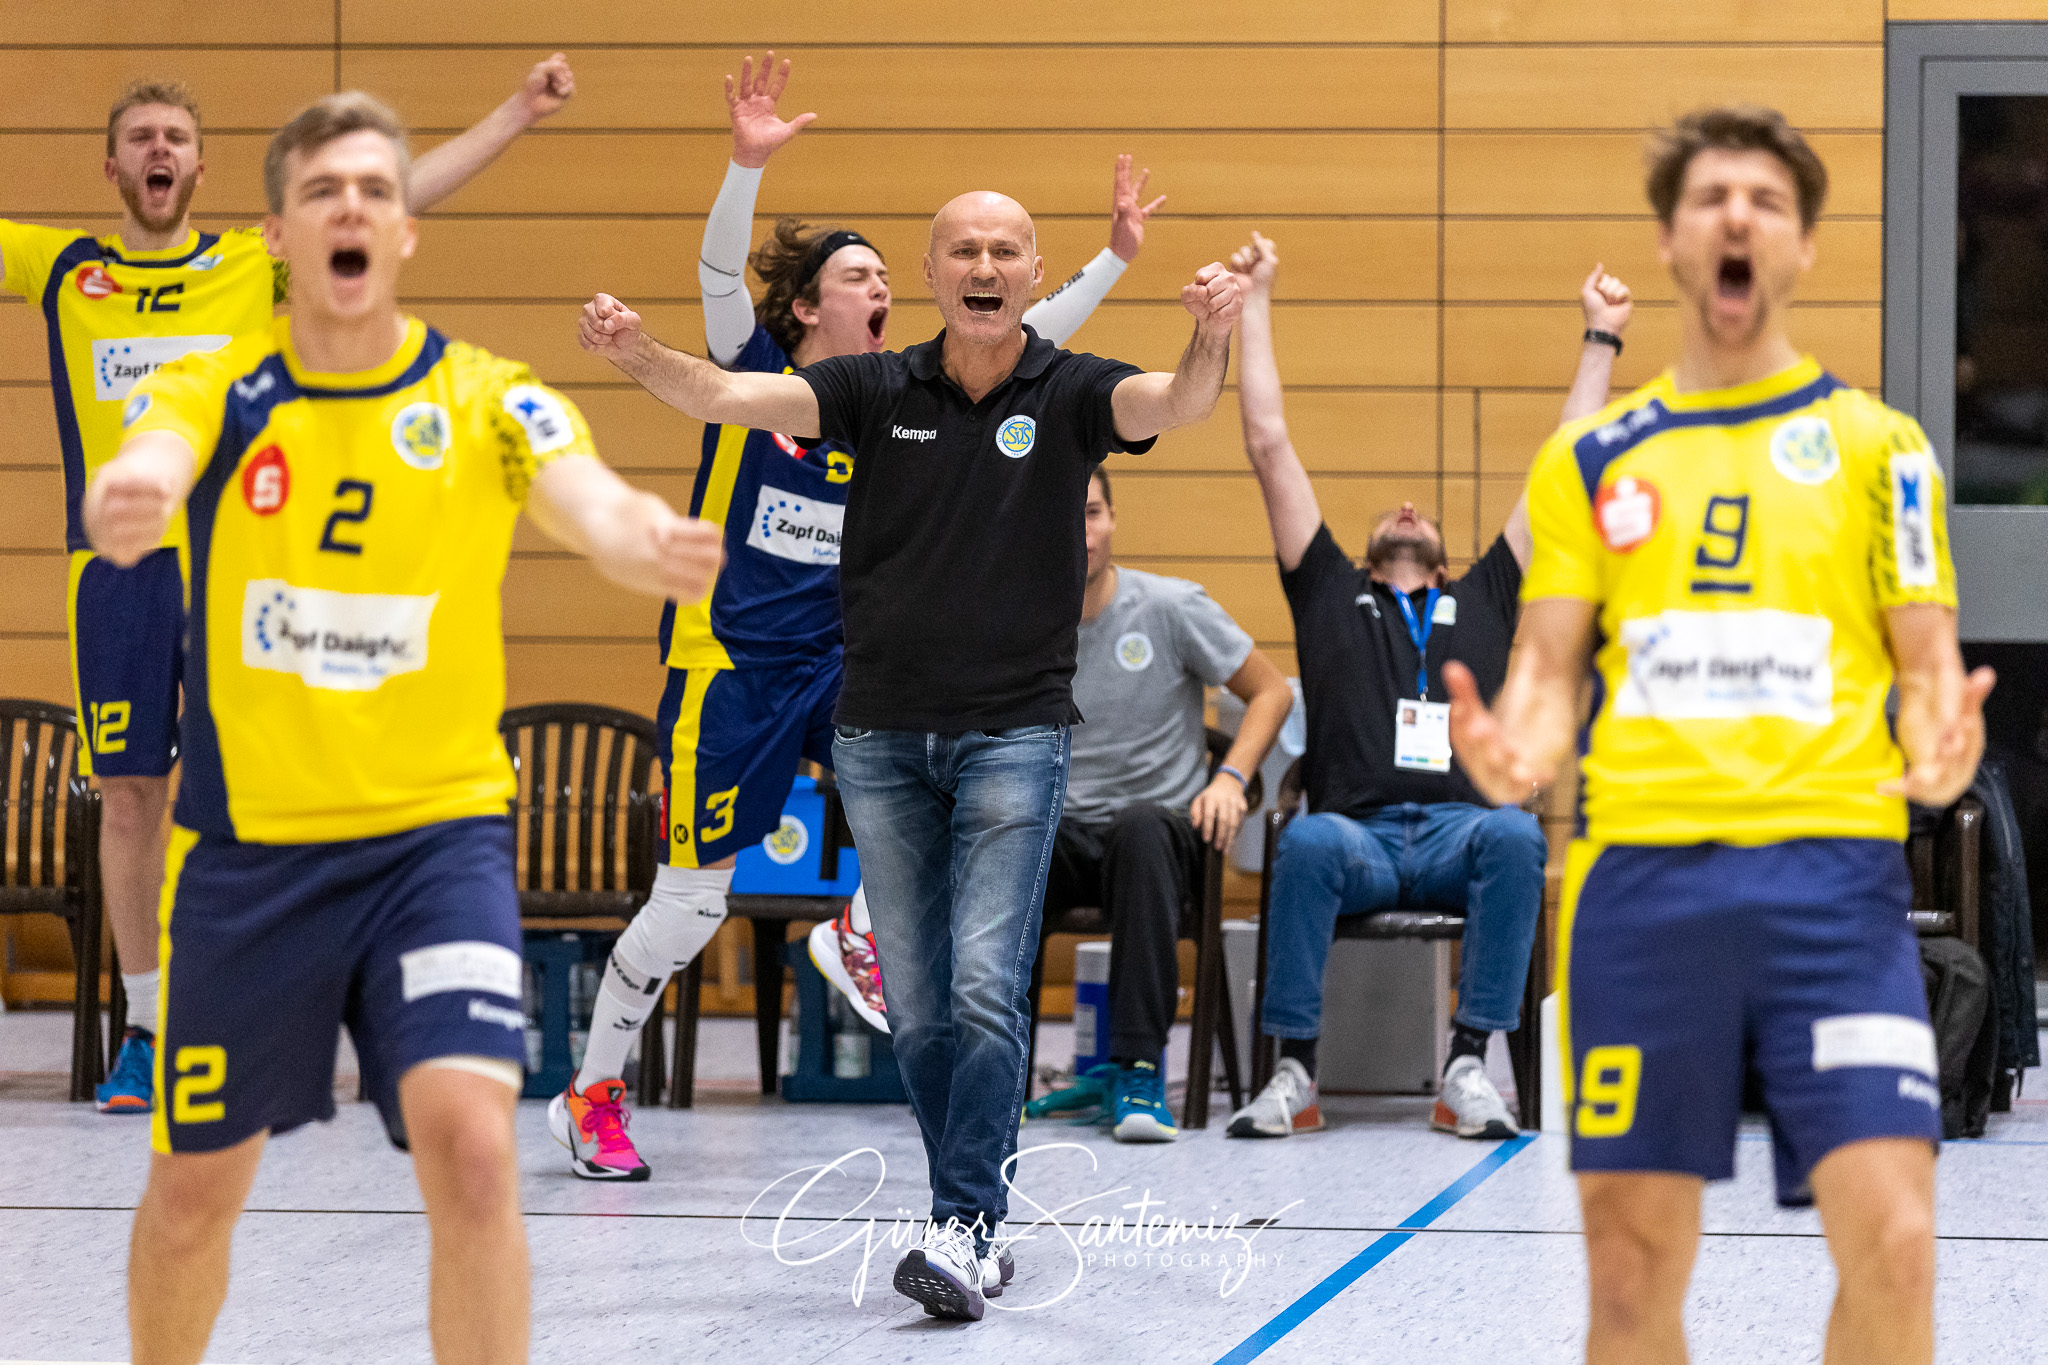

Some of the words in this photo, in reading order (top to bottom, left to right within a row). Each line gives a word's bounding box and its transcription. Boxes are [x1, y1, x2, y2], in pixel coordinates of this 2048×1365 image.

[114, 363, 150, 379] Zapf
[891, 424, 937, 443] Kempa
[319, 478, 374, 556] 2
[777, 518, 816, 540] Zapf
[1696, 494, 1749, 569] 9
[90, 700, 131, 755] 12
[701, 785, 739, 843] 3
[173, 1046, 227, 1124] 2
[1576, 1045, 1641, 1138] 9
